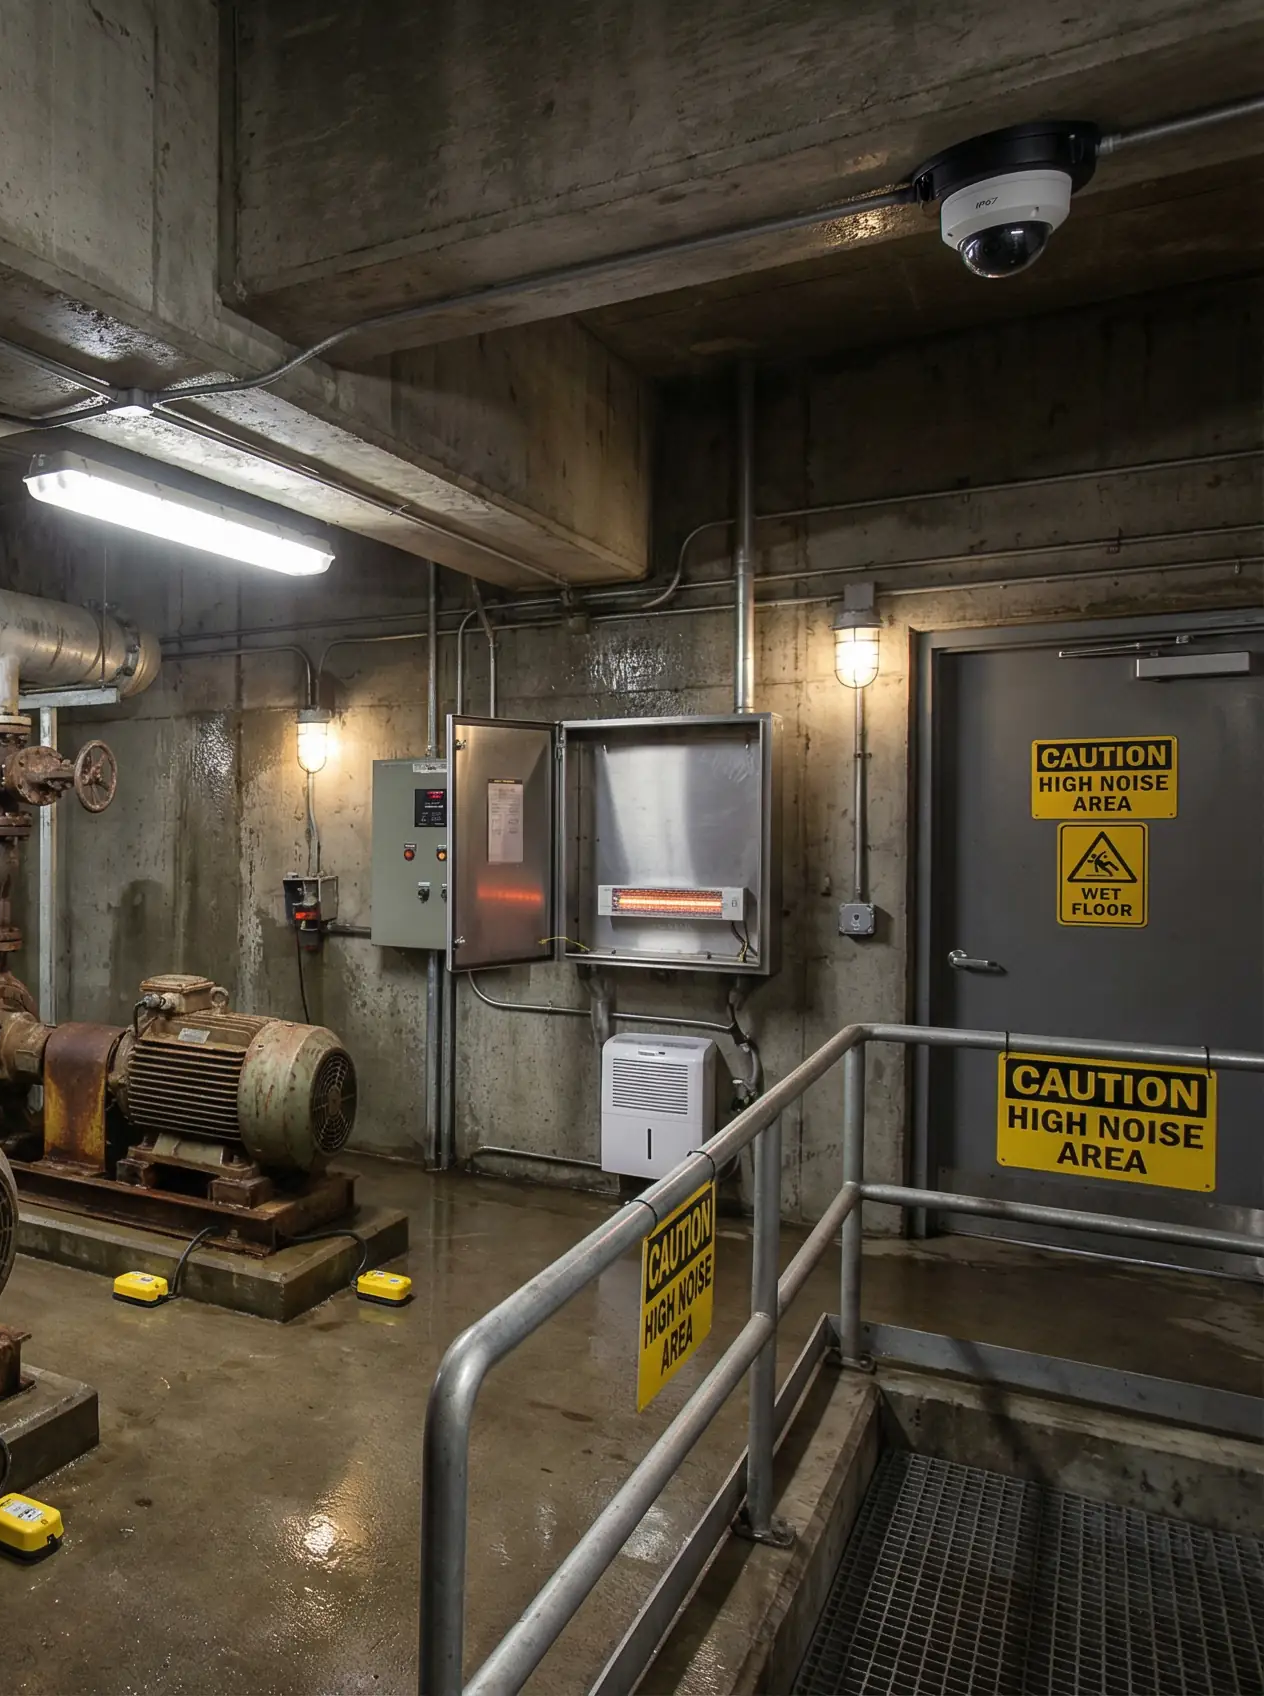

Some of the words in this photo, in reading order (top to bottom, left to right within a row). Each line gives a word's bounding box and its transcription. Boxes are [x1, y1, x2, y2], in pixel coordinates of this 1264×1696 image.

[1041, 744, 1167, 769] CAUTION
[1039, 776, 1092, 792] HIGH
[1100, 774, 1169, 792] NOISE
[1072, 796, 1132, 812] AREA
[1071, 903, 1132, 916] FLOOR
[1081, 887, 1122, 901] WET
[1012, 1065, 1198, 1112] CAUTION
[1008, 1105, 1087, 1136] HIGH
[1099, 1114, 1204, 1150] NOISE
[1056, 1141, 1147, 1174] AREA
[648, 1199, 711, 1290] CAUTION
[644, 1287, 676, 1350] HIGH
[678, 1253, 712, 1315] NOISE
[660, 1314, 693, 1376] AREA
